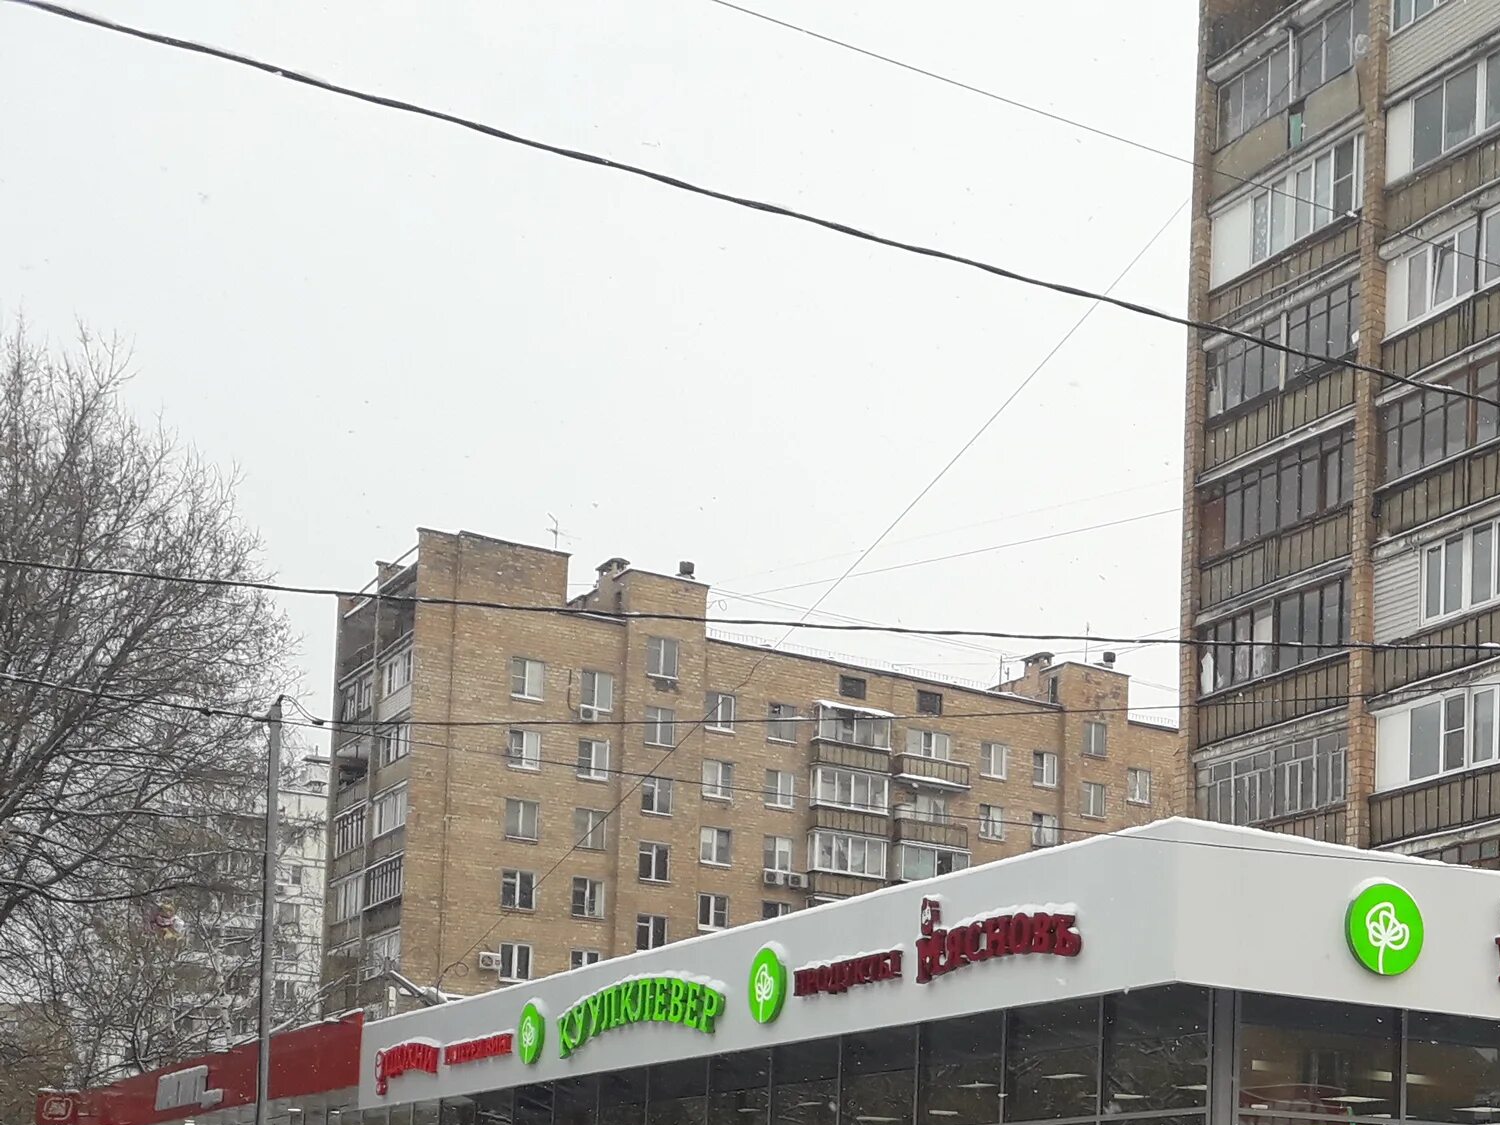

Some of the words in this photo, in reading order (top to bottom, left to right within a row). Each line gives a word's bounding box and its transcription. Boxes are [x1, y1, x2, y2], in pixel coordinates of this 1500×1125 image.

[793, 950, 904, 996] ПРОДУКТЫ
[915, 912, 1083, 984] МЯСНОВЪ
[558, 977, 727, 1059] КУУЛКЛЕВЕР
